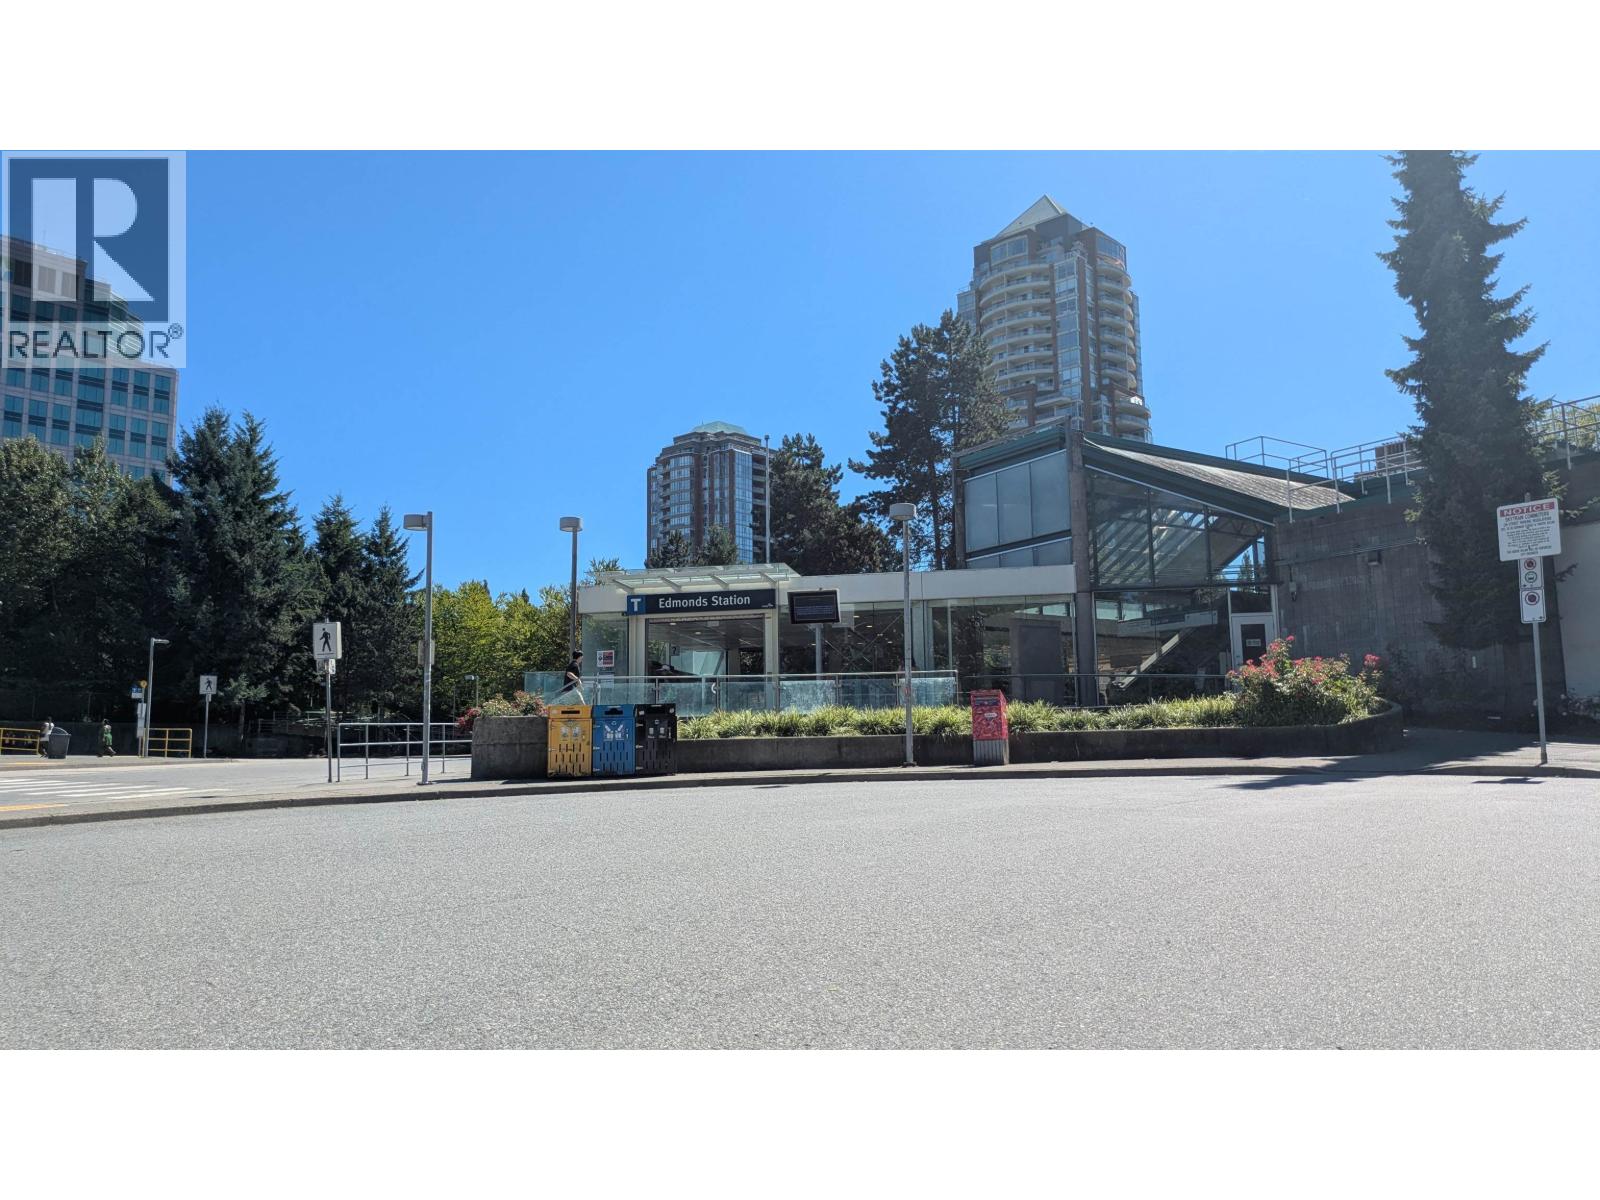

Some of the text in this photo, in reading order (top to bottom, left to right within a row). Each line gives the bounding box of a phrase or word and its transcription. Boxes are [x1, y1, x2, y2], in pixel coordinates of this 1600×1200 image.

[1503, 503, 1550, 516] NOTICE
[630, 594, 751, 612] T Edmonds Station
